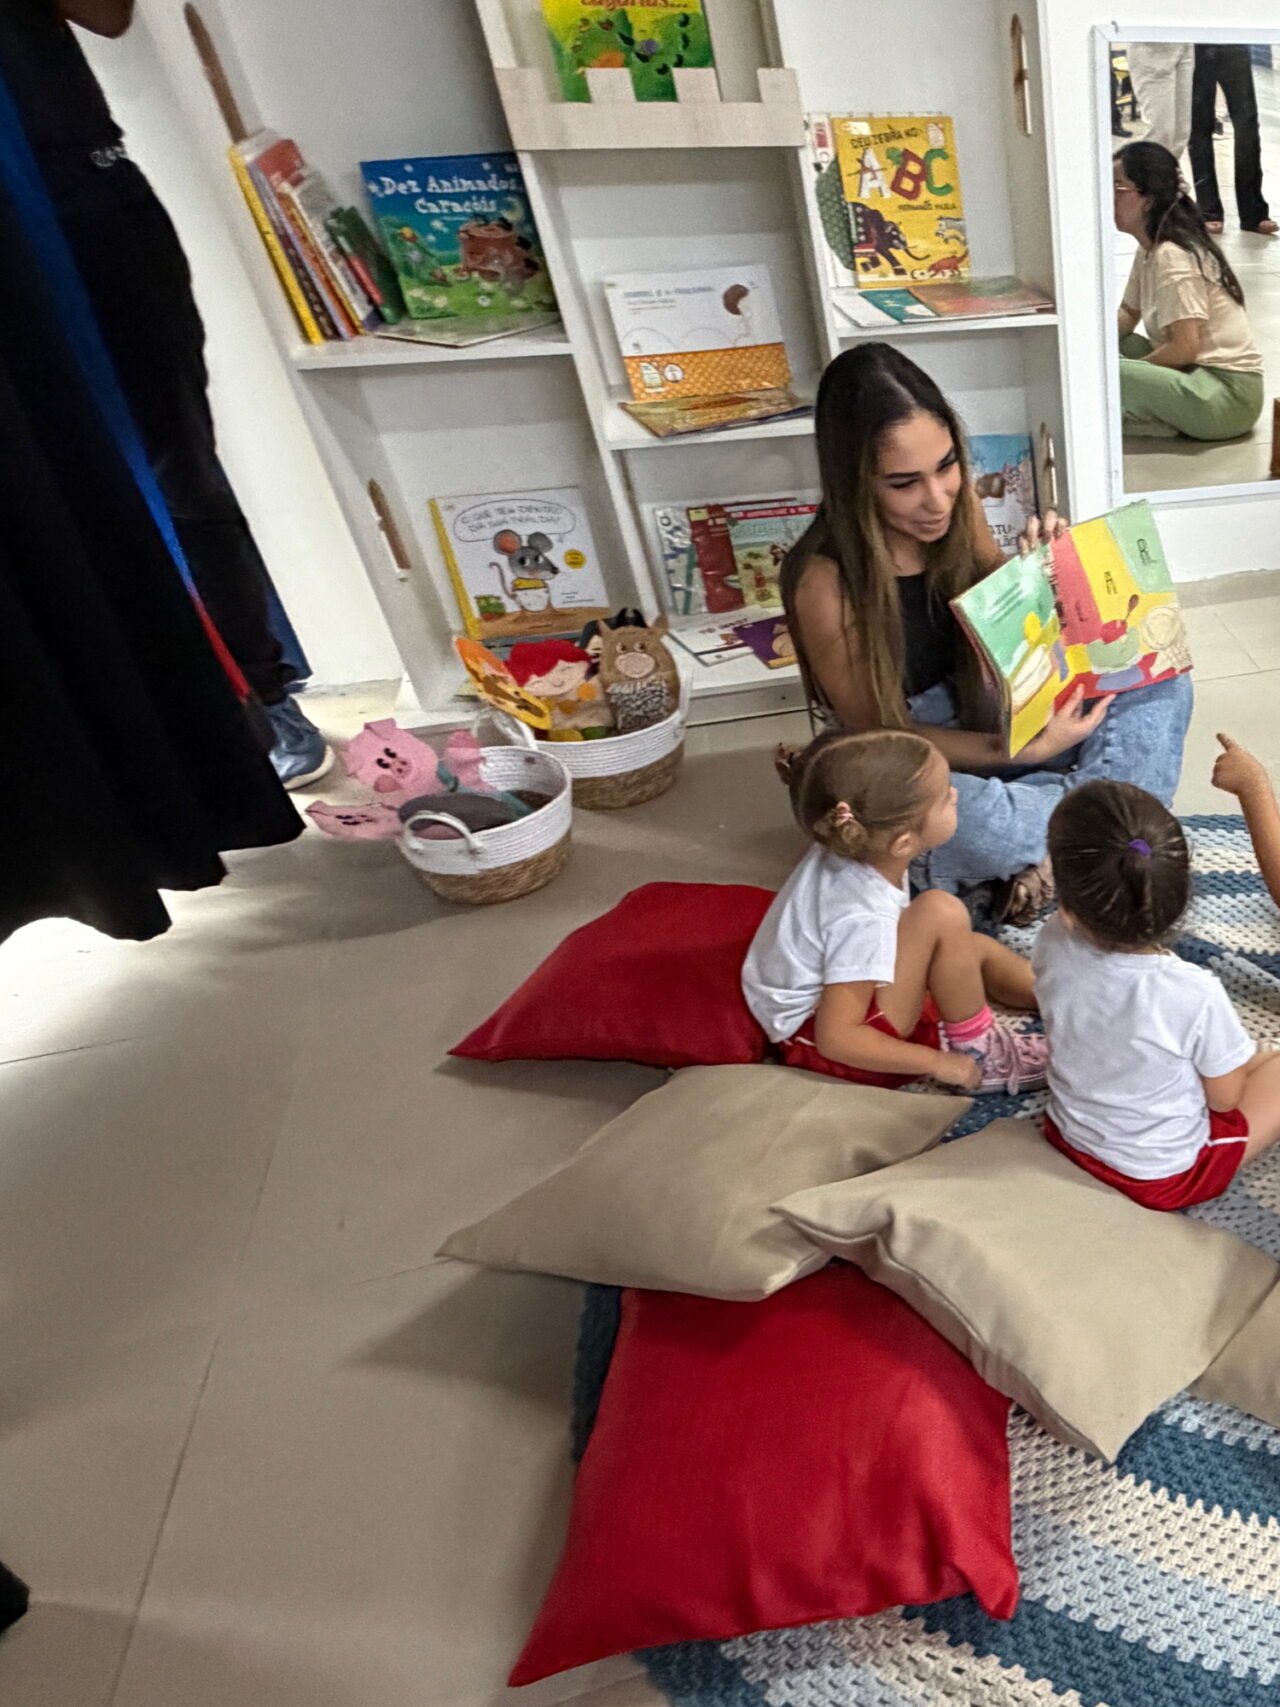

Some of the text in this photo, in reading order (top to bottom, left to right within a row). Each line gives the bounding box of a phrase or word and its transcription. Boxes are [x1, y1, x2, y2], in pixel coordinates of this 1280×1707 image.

[379, 174, 518, 195] Dez Animados
[857, 148, 953, 200] ABC
[414, 196, 498, 214] Caracóis
